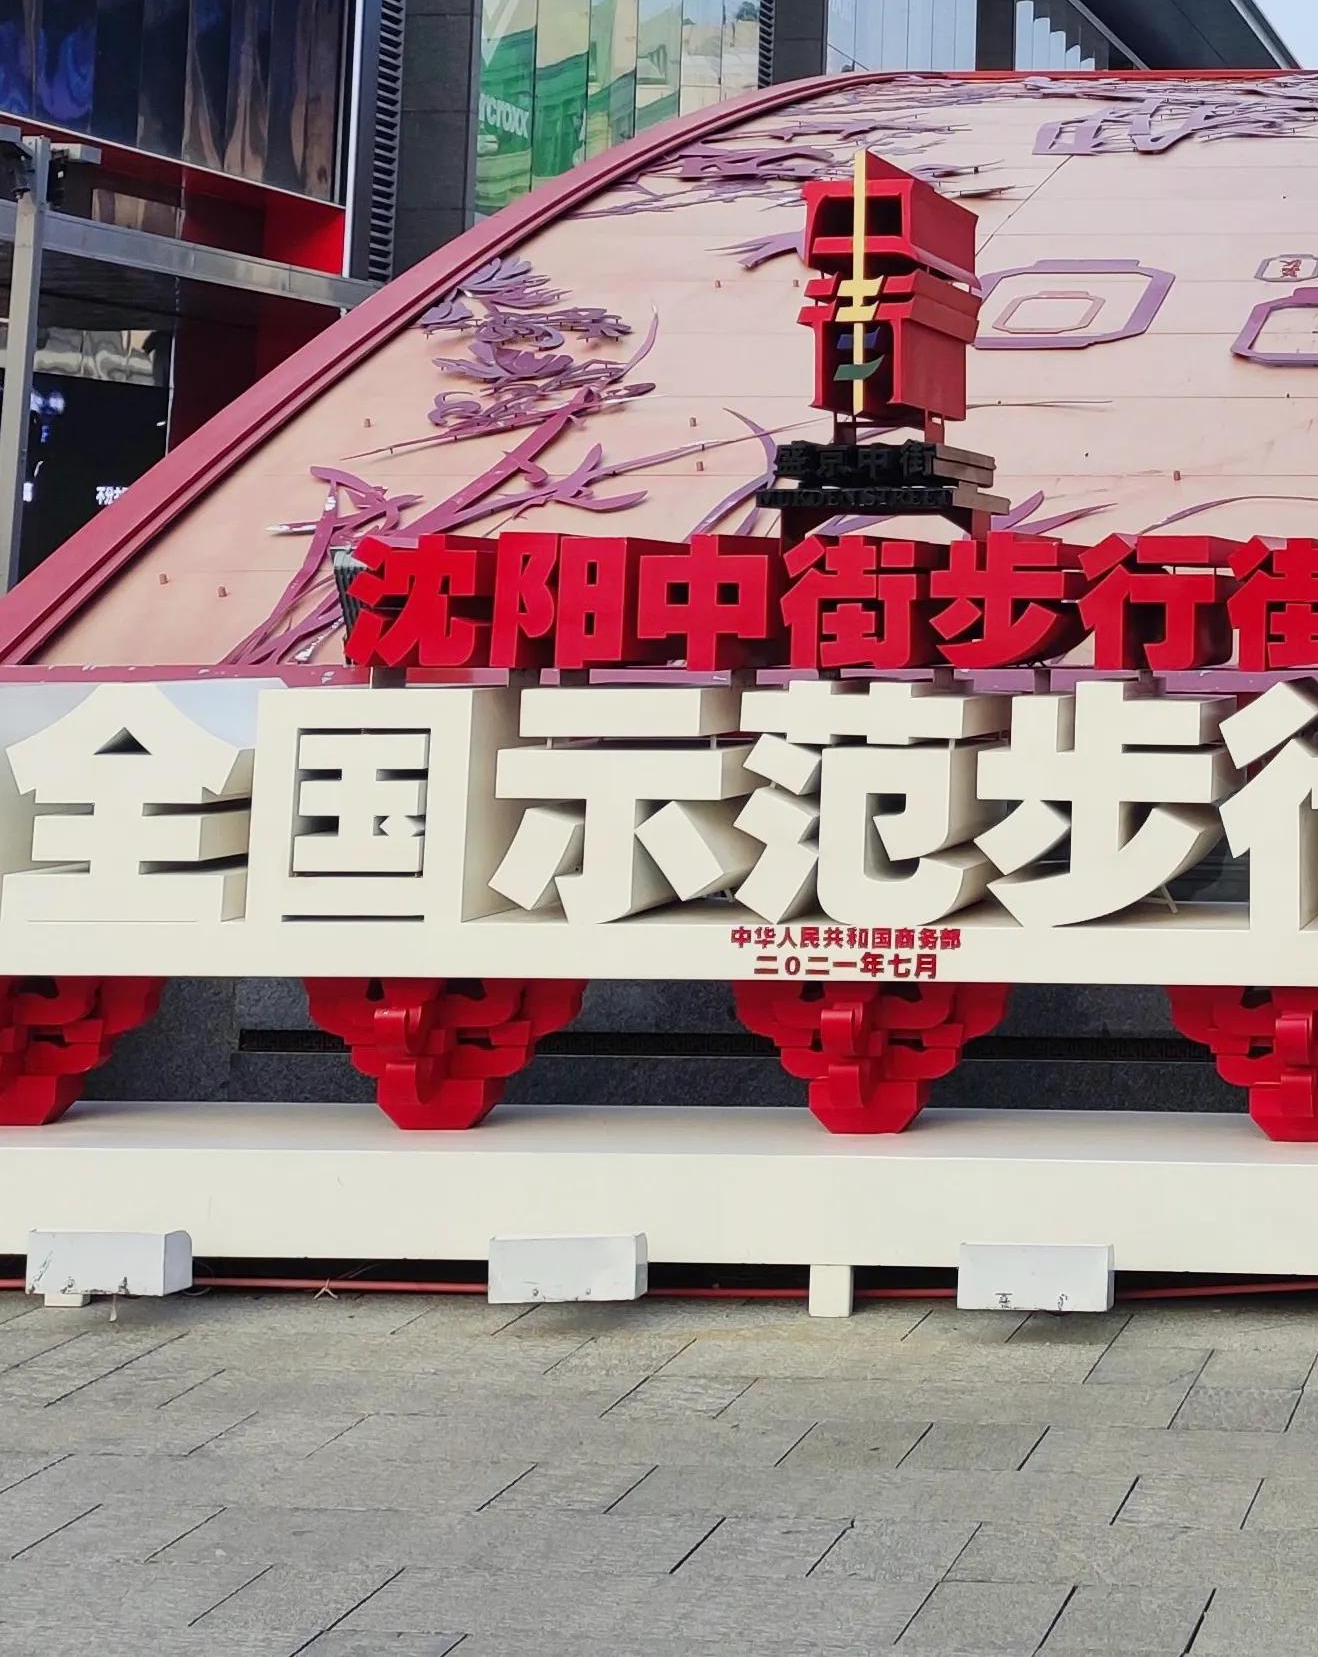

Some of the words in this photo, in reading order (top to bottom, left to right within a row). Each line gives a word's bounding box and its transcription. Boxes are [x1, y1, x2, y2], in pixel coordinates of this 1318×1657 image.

[730, 926, 961, 950] 中华人民共和国商务部
